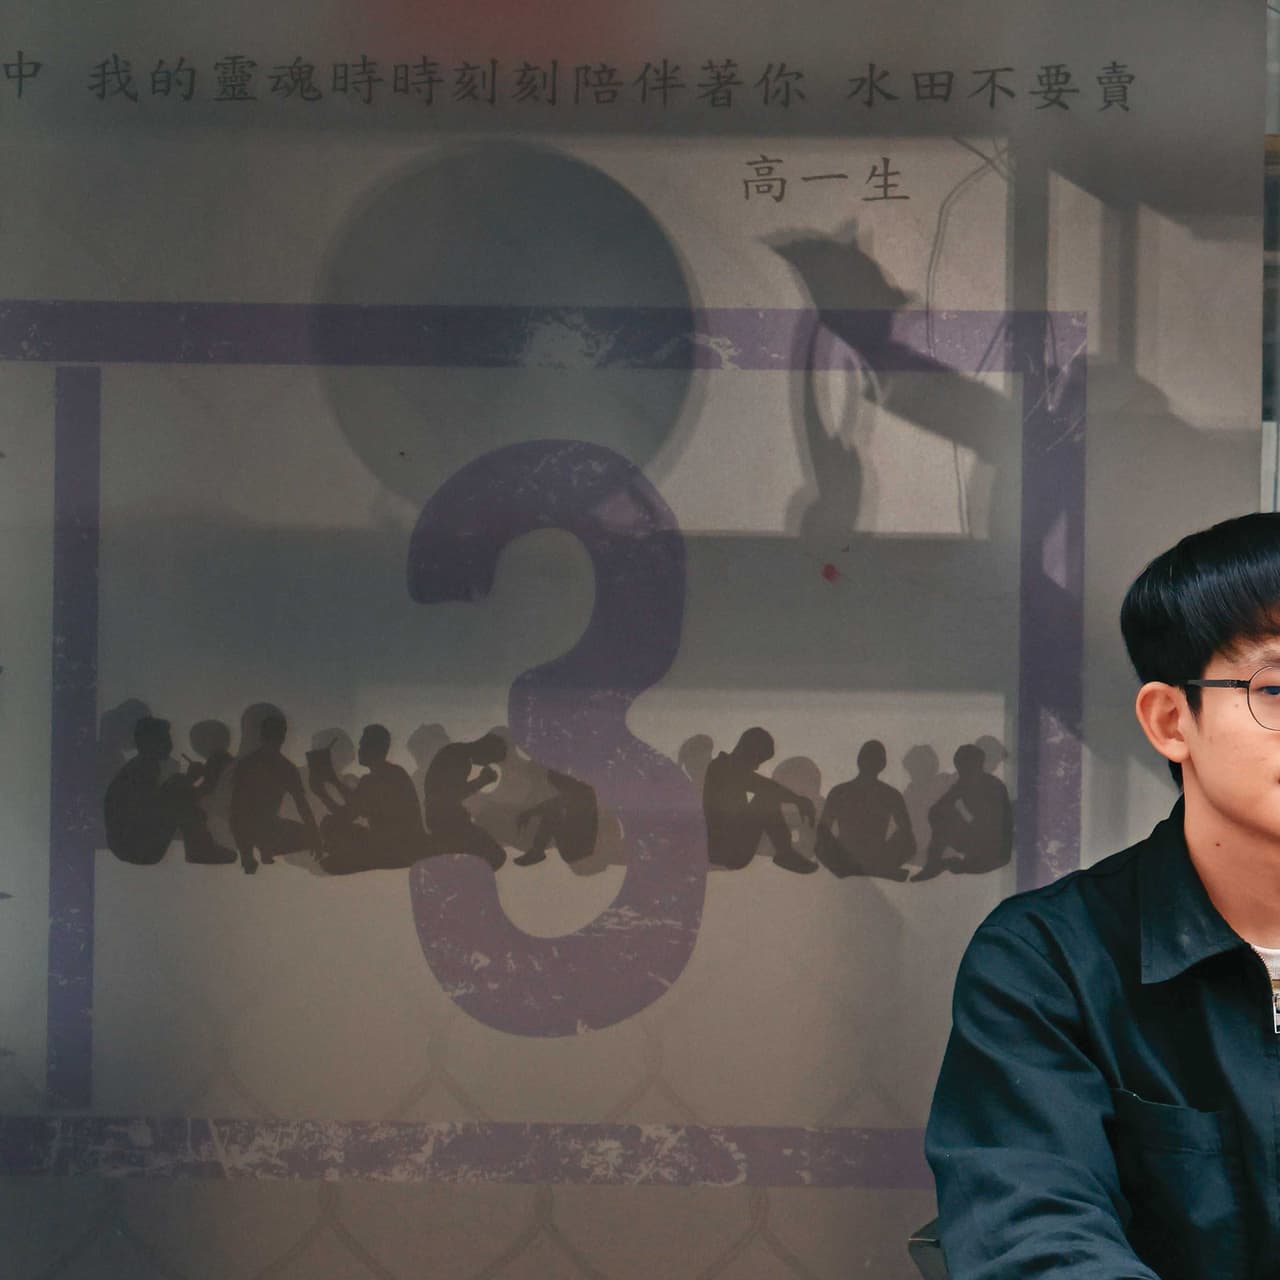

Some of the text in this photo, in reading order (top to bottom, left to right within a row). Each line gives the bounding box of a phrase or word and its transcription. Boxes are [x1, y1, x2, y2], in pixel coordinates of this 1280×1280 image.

[2, 50, 1137, 112] 中 我的靈魂時時刻刻陪伴著你 水田不要賣
[743, 155, 910, 203] 高一生
